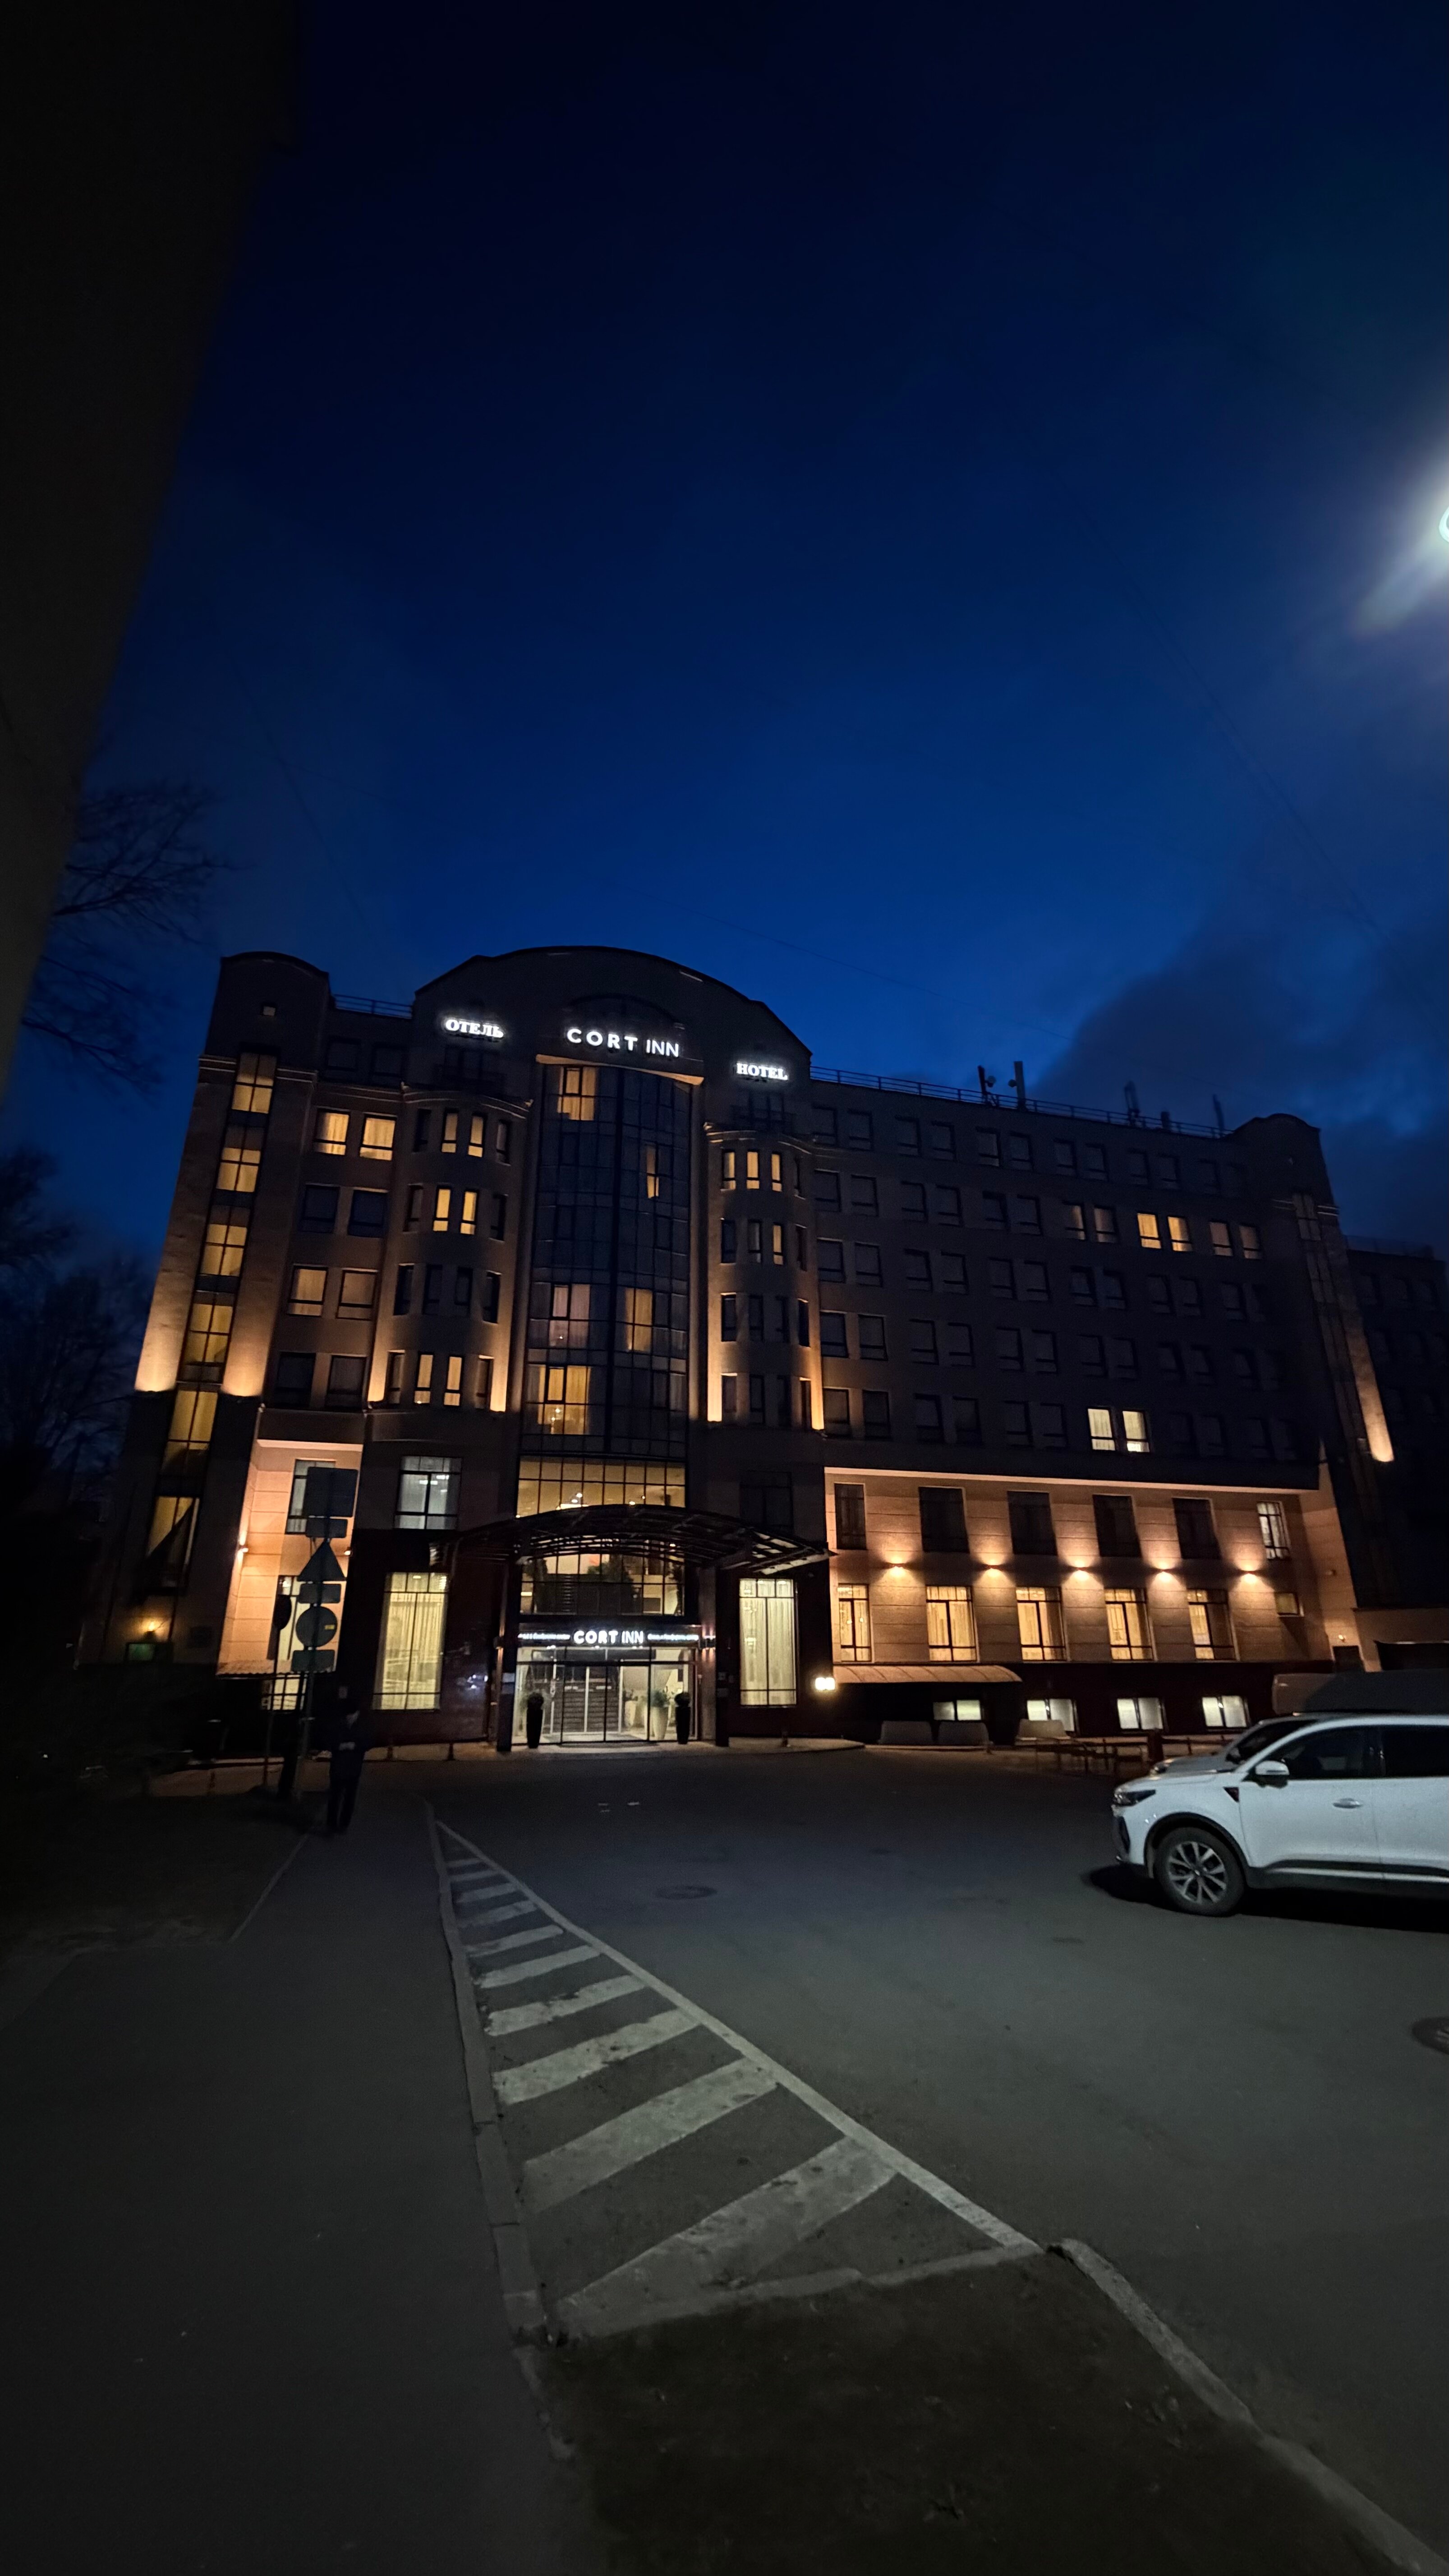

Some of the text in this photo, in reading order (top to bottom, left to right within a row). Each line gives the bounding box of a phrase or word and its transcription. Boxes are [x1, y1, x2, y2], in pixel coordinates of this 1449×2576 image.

[445, 1019, 504, 1038] ОТЕЛЬ
[566, 1028, 679, 1057] CORT INN
[736, 1063, 788, 1081] HOTEL
[573, 1630, 618, 1644] CORT
[621, 1630, 644, 1644] INN
